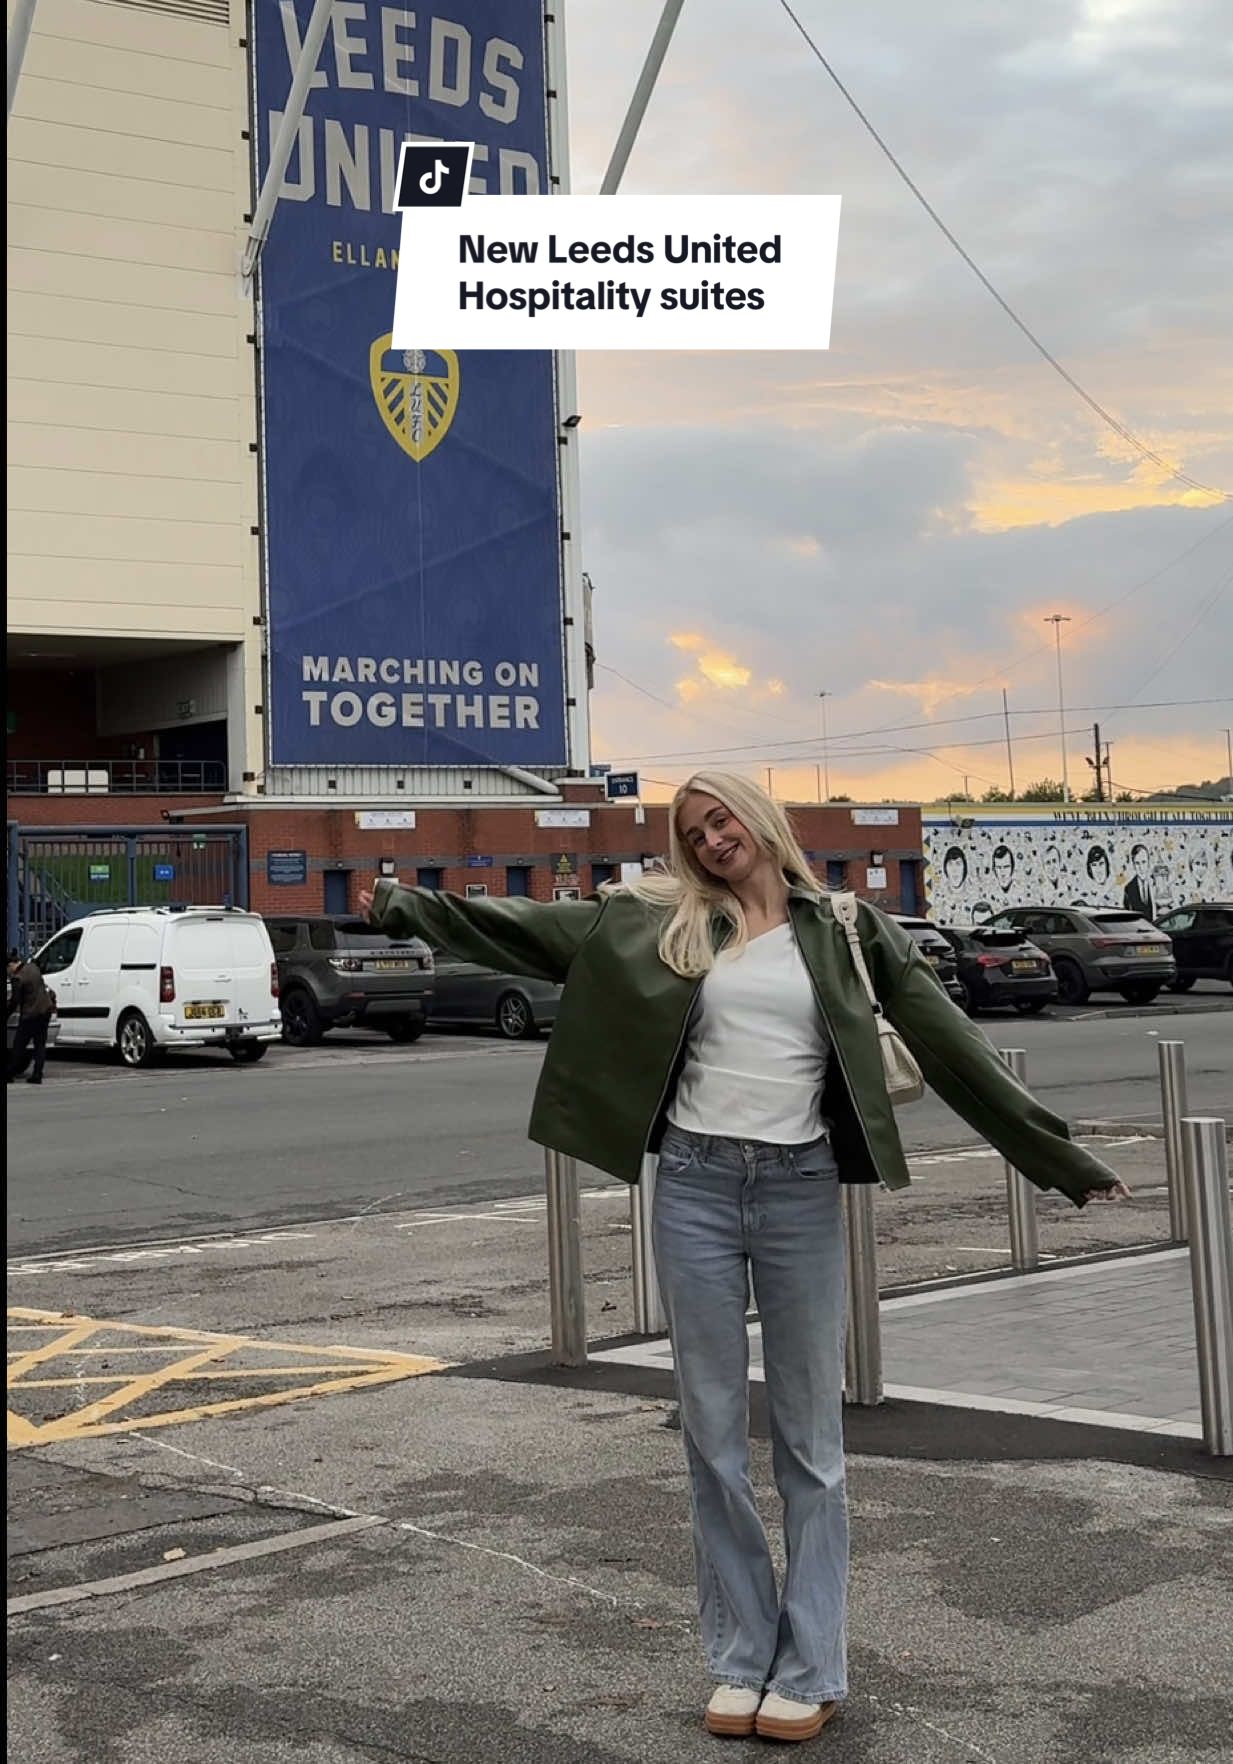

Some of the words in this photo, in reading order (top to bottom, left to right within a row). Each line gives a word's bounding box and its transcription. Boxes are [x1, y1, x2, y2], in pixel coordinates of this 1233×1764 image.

[280, 0, 524, 125] LEEDS
[268, 110, 541, 216] UNID
[302, 655, 484, 686] MARCHING
[494, 661, 539, 688] ON
[302, 690, 540, 729] TOGETHER
